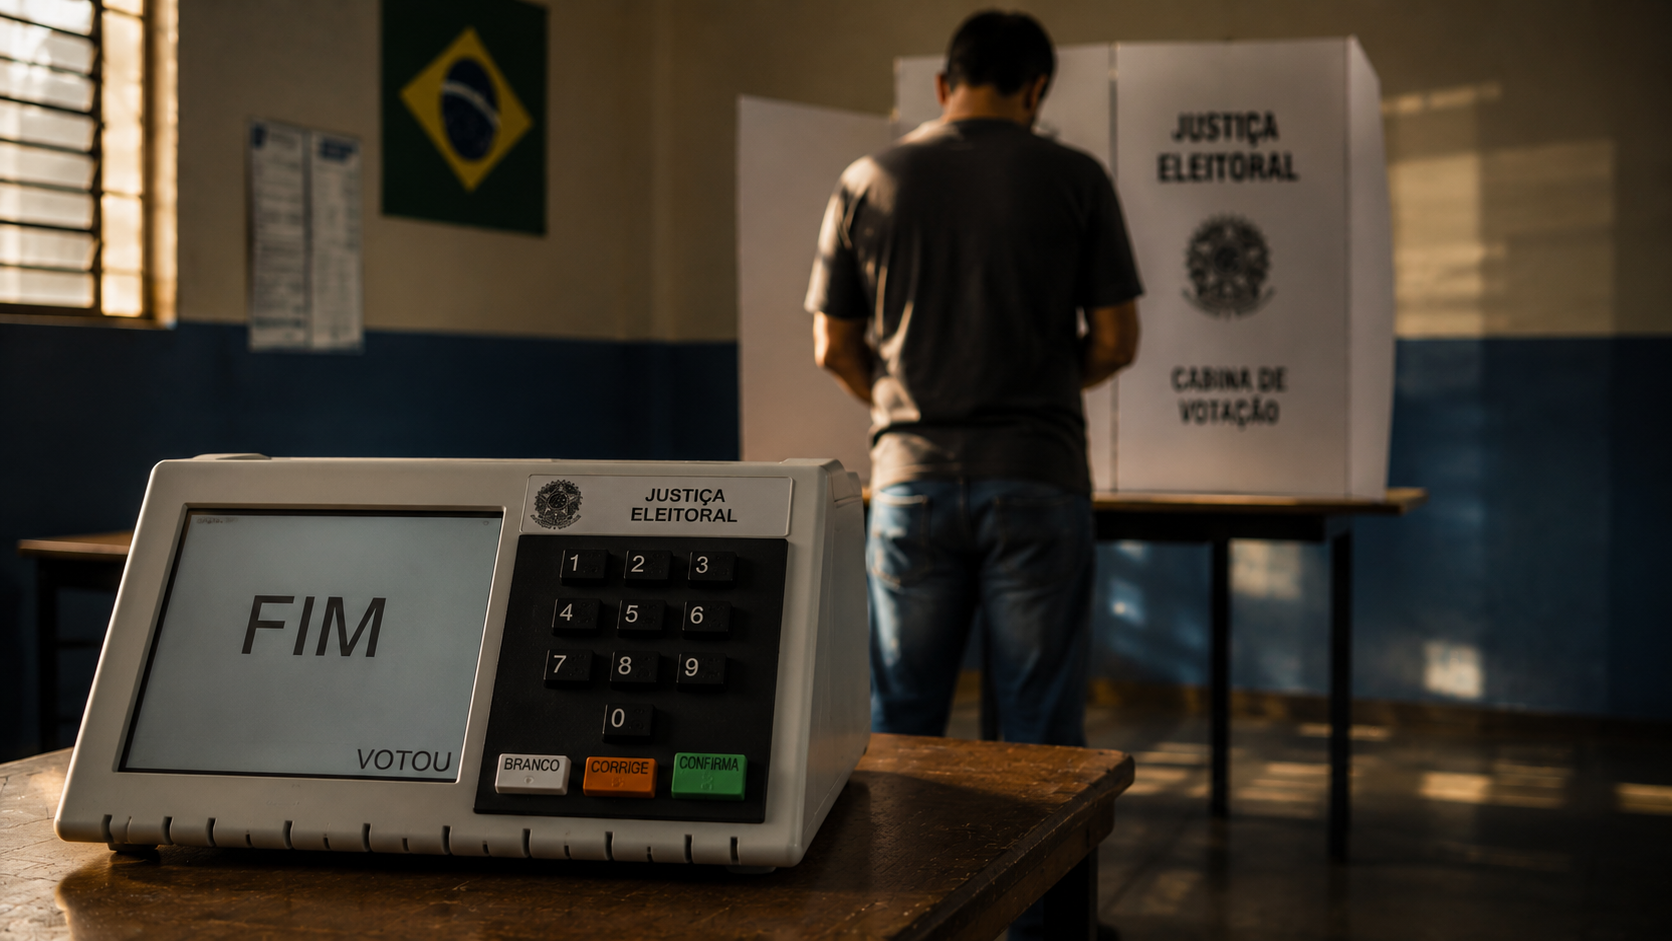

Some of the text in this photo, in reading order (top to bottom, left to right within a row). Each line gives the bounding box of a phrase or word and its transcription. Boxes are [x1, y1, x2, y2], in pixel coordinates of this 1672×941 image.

[1171, 110, 1280, 148] JUSTIÇA
[1158, 153, 1299, 183] ELEITORAL
[1171, 366, 1288, 393] CABINA DE
[1179, 394, 1280, 430] VOTAÇÃO
[645, 488, 725, 505] JUSTIÇA
[630, 508, 738, 523] ELEITORAL
[569, 554, 709, 574] 1 2 3
[559, 604, 704, 624] 4 5 6
[241, 595, 387, 658] FIM
[553, 655, 699, 676] 7 8 9
[611, 708, 625, 728] 0
[357, 748, 452, 773] VOTOU
[504, 758, 560, 772] BRANCO
[591, 760, 649, 775] CORRIGE
[679, 756, 740, 772] CONFIRMA
